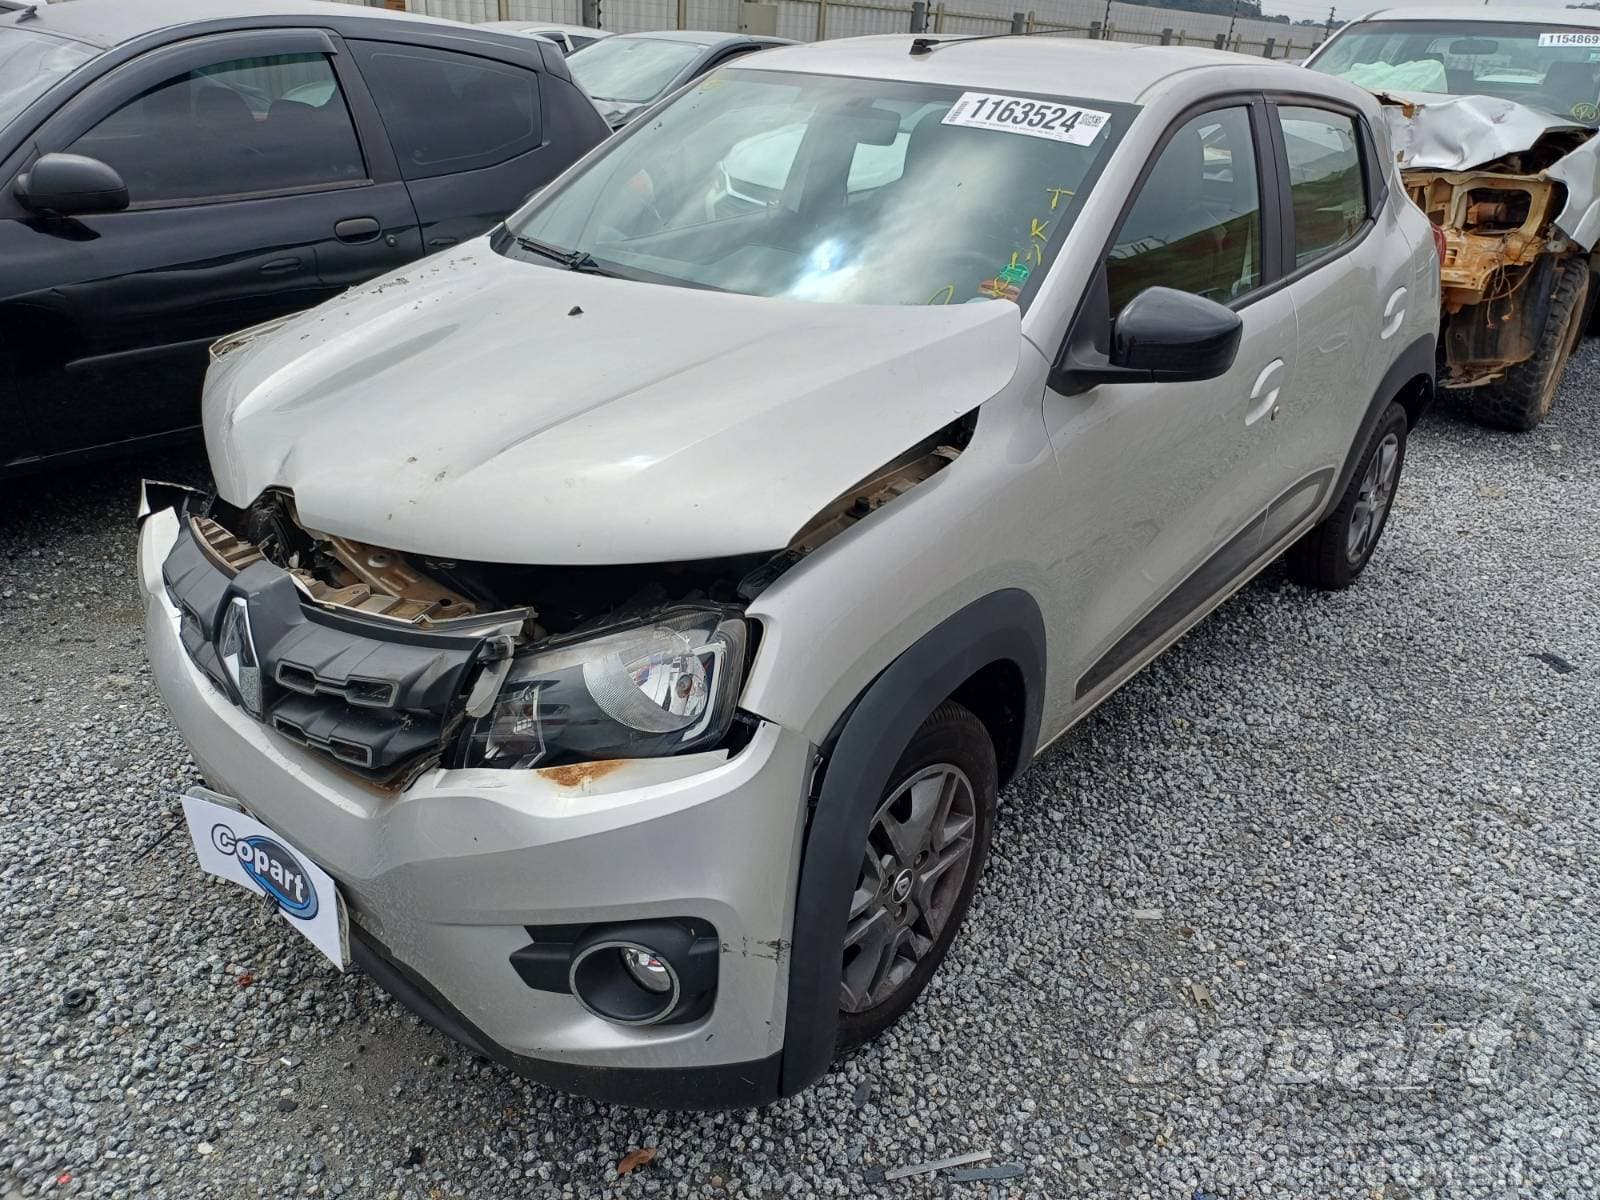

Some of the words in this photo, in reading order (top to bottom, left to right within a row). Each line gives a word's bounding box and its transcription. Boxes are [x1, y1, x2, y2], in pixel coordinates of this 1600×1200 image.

[1548, 34, 1599, 45] 1154869
[970, 97, 1083, 134] 1163524
[210, 822, 305, 904] Copart
